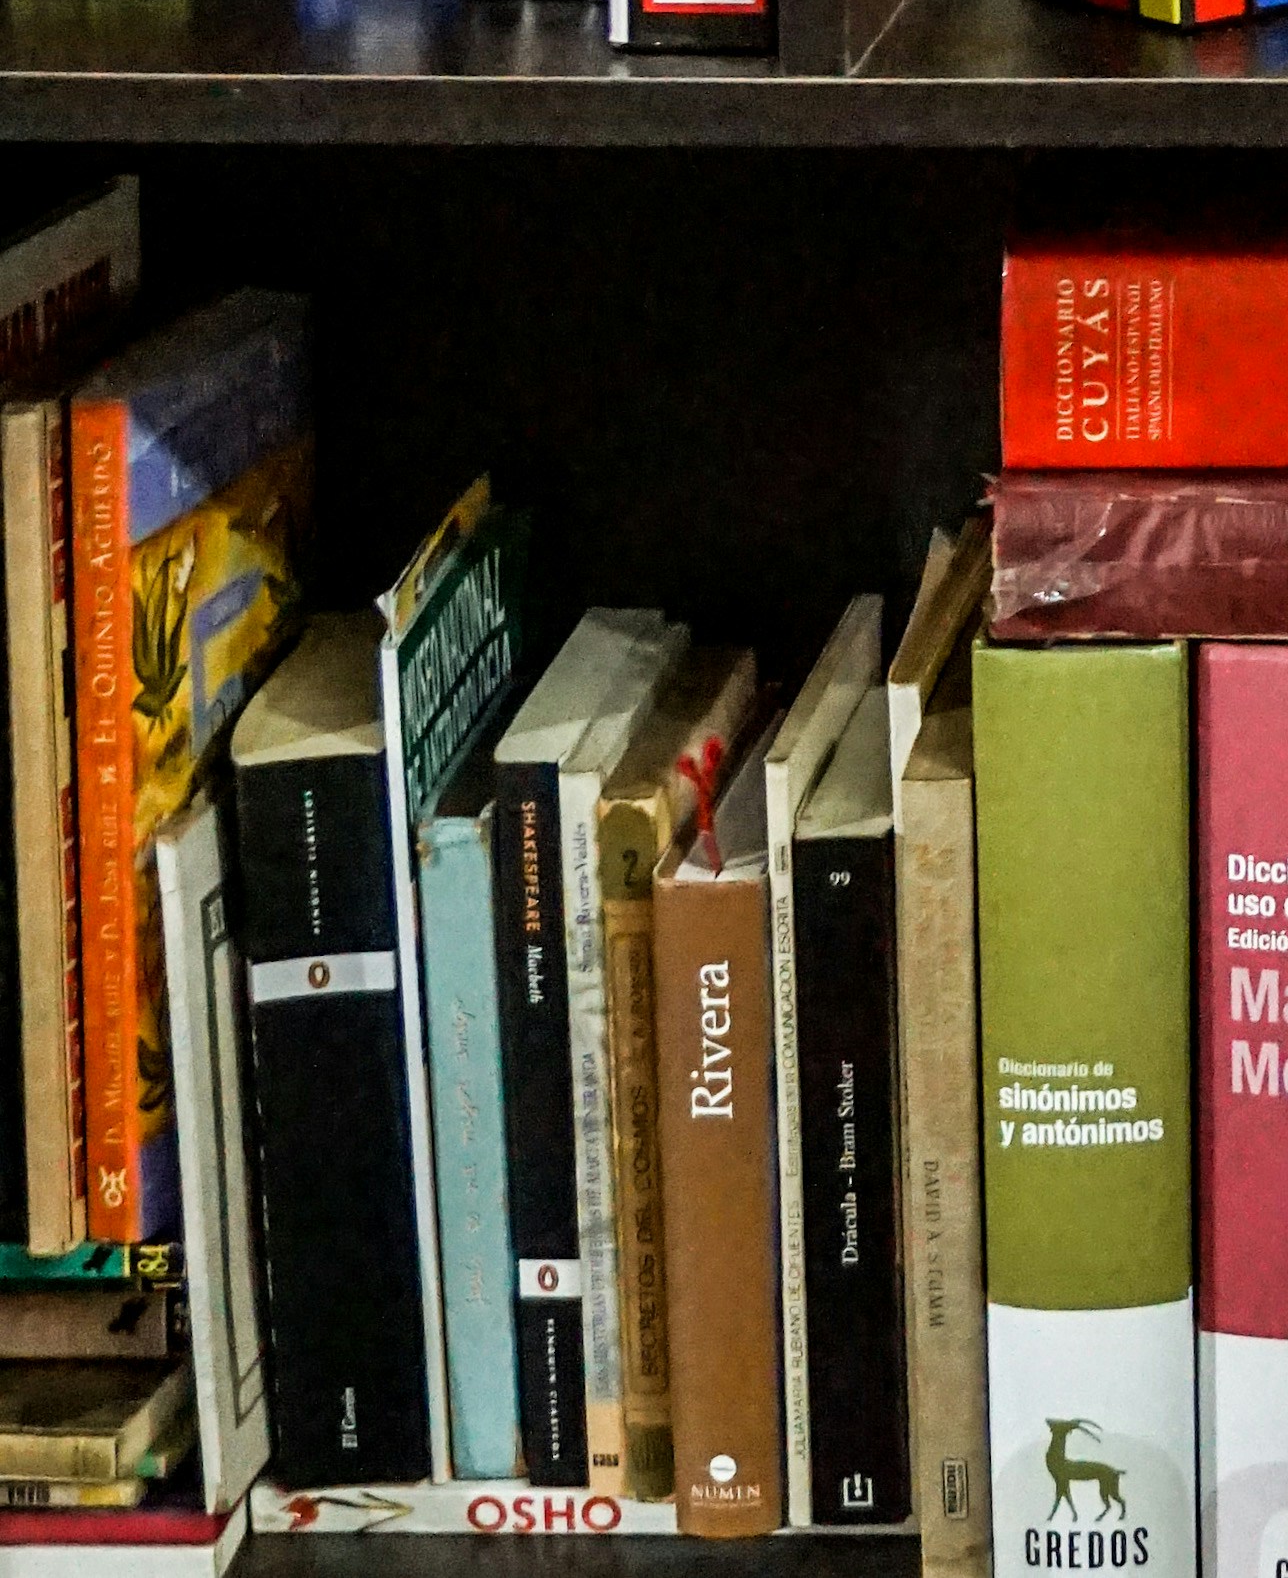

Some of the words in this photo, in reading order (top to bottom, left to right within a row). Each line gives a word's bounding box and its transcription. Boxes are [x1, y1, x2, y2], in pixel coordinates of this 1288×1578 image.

[1056, 279, 1074, 440] DICCIONARIO
[1082, 279, 1109, 442] CUYÁS
[830, 870, 851, 887] 99
[1228, 893, 1276, 917] uso
[690, 960, 733, 1119] Rivera
[836, 1060, 854, 1118] Stoker
[998, 1080, 1138, 1112] sinónimos
[838, 1122, 857, 1170] Bram
[1000, 1120, 1015, 1148] y
[1021, 1111, 1169, 1146] antónimos
[839, 1192, 859, 1264] Drácula
[467, 1497, 620, 1533] OSHO
[1025, 1526, 1149, 1569] GREDOS
